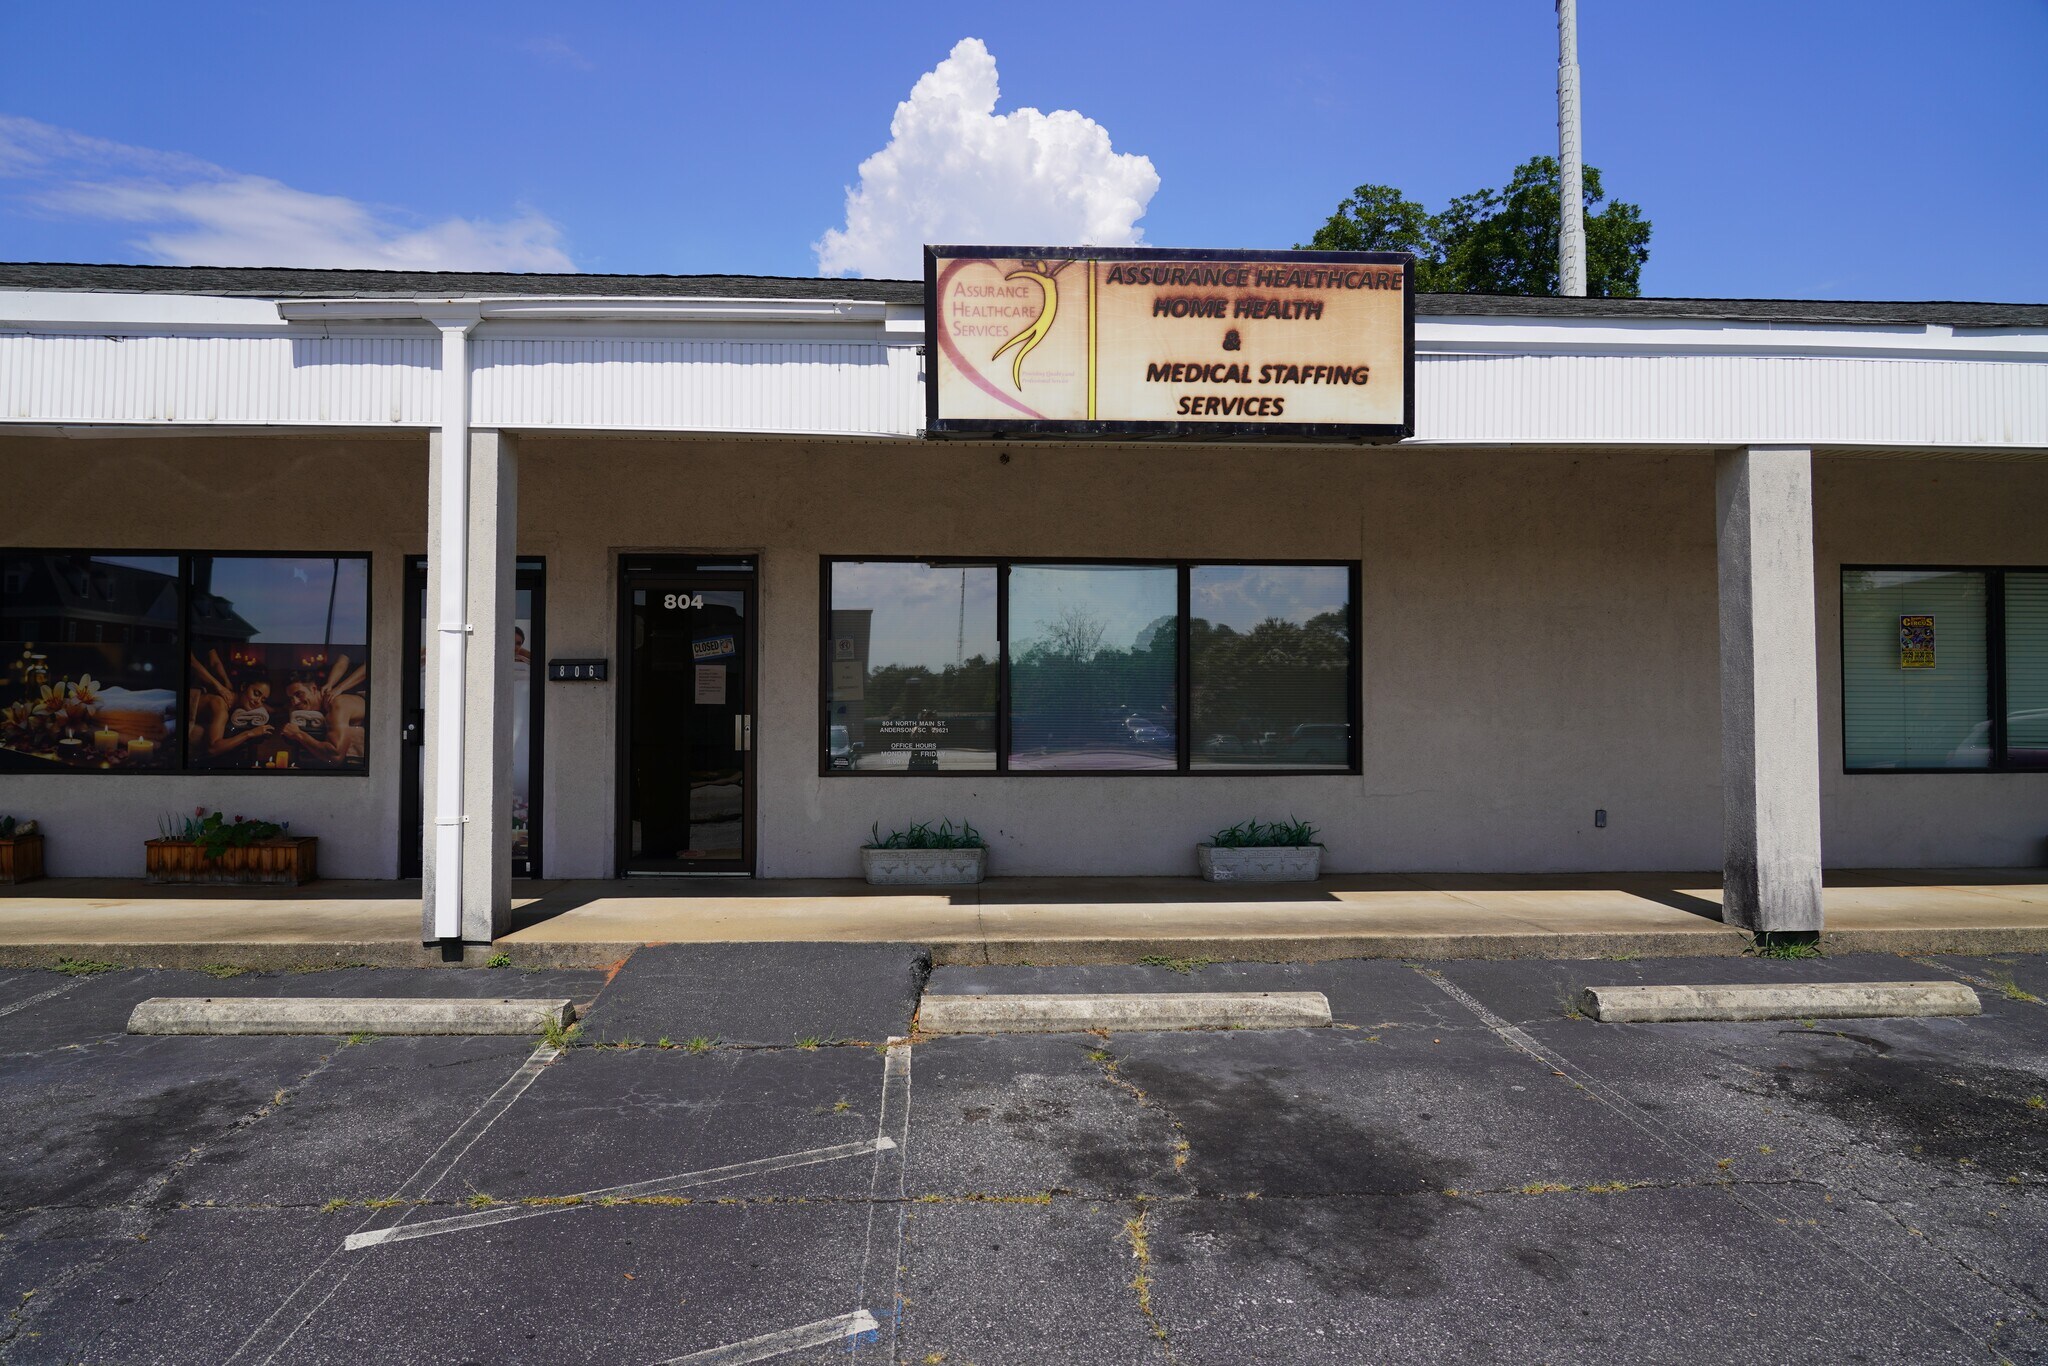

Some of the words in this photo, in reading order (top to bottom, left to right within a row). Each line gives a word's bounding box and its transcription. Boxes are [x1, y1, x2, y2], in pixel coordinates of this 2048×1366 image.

[1106, 266, 1249, 287] ASSURANCE
[1255, 269, 1404, 290] HEALTHCARE
[953, 282, 1030, 298] ASSURANCE
[952, 301, 1036, 318] HEALTHCARE
[1152, 298, 1228, 318] HOME
[1233, 300, 1324, 320] HEALTH
[952, 320, 1009, 337] SERVICES
[1222, 329, 1241, 351] &
[1146, 363, 1252, 383] MEDICAL
[1258, 364, 1370, 385] STAFFING
[1176, 396, 1285, 416] SERVICES
[663, 594, 704, 610] 804
[1903, 618, 1933, 626] CIRCUS
[693, 640, 719, 653] CLOSED
